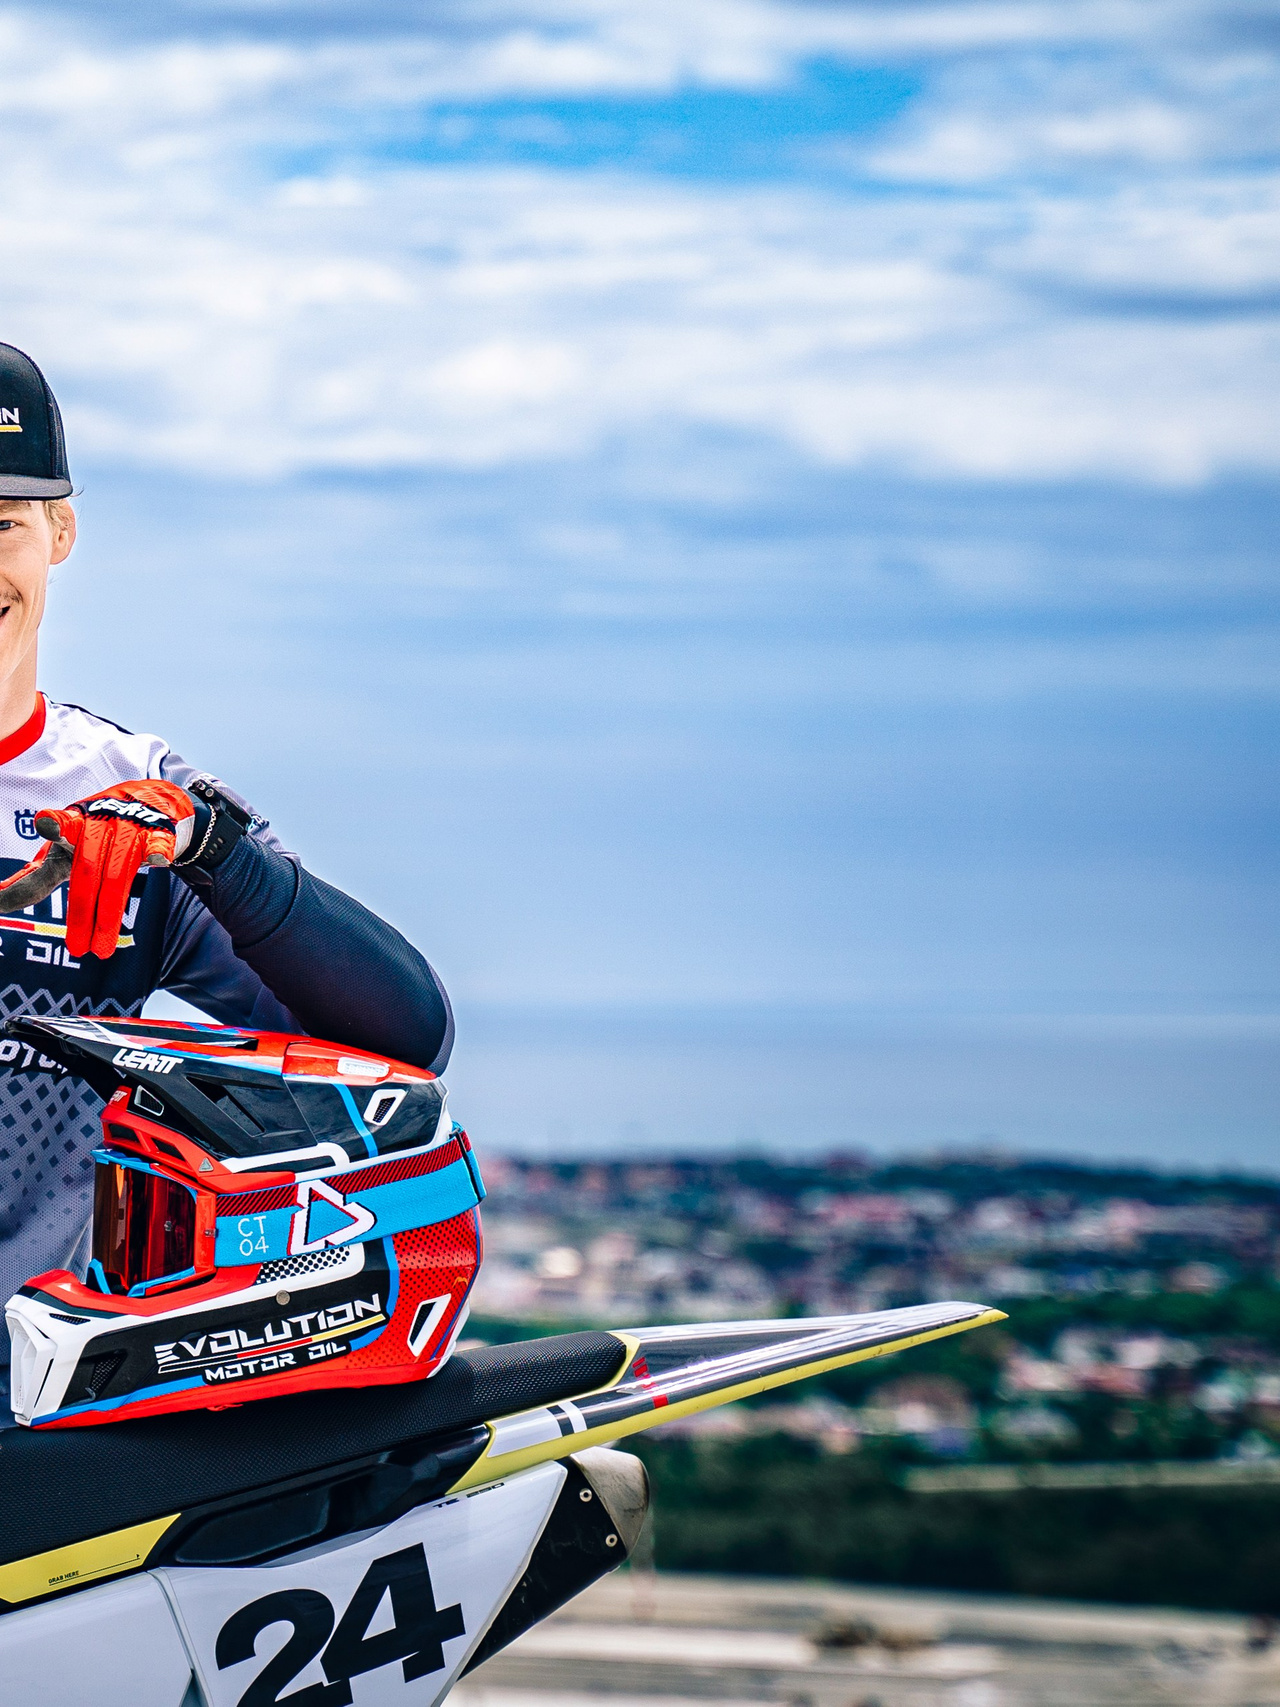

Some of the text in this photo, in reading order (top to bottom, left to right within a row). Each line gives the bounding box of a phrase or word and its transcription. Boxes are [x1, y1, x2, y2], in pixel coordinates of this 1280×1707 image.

[88, 797, 171, 823] LEATT
[25, 939, 81, 969] OIL
[112, 1048, 184, 1074] LEATT
[238, 1215, 267, 1237] CT
[239, 1236, 269, 1256] 04
[154, 1293, 383, 1365] EVOLUTION
[204, 1342, 346, 1381] MOTOR OIL
[216, 1542, 465, 1707] 24
